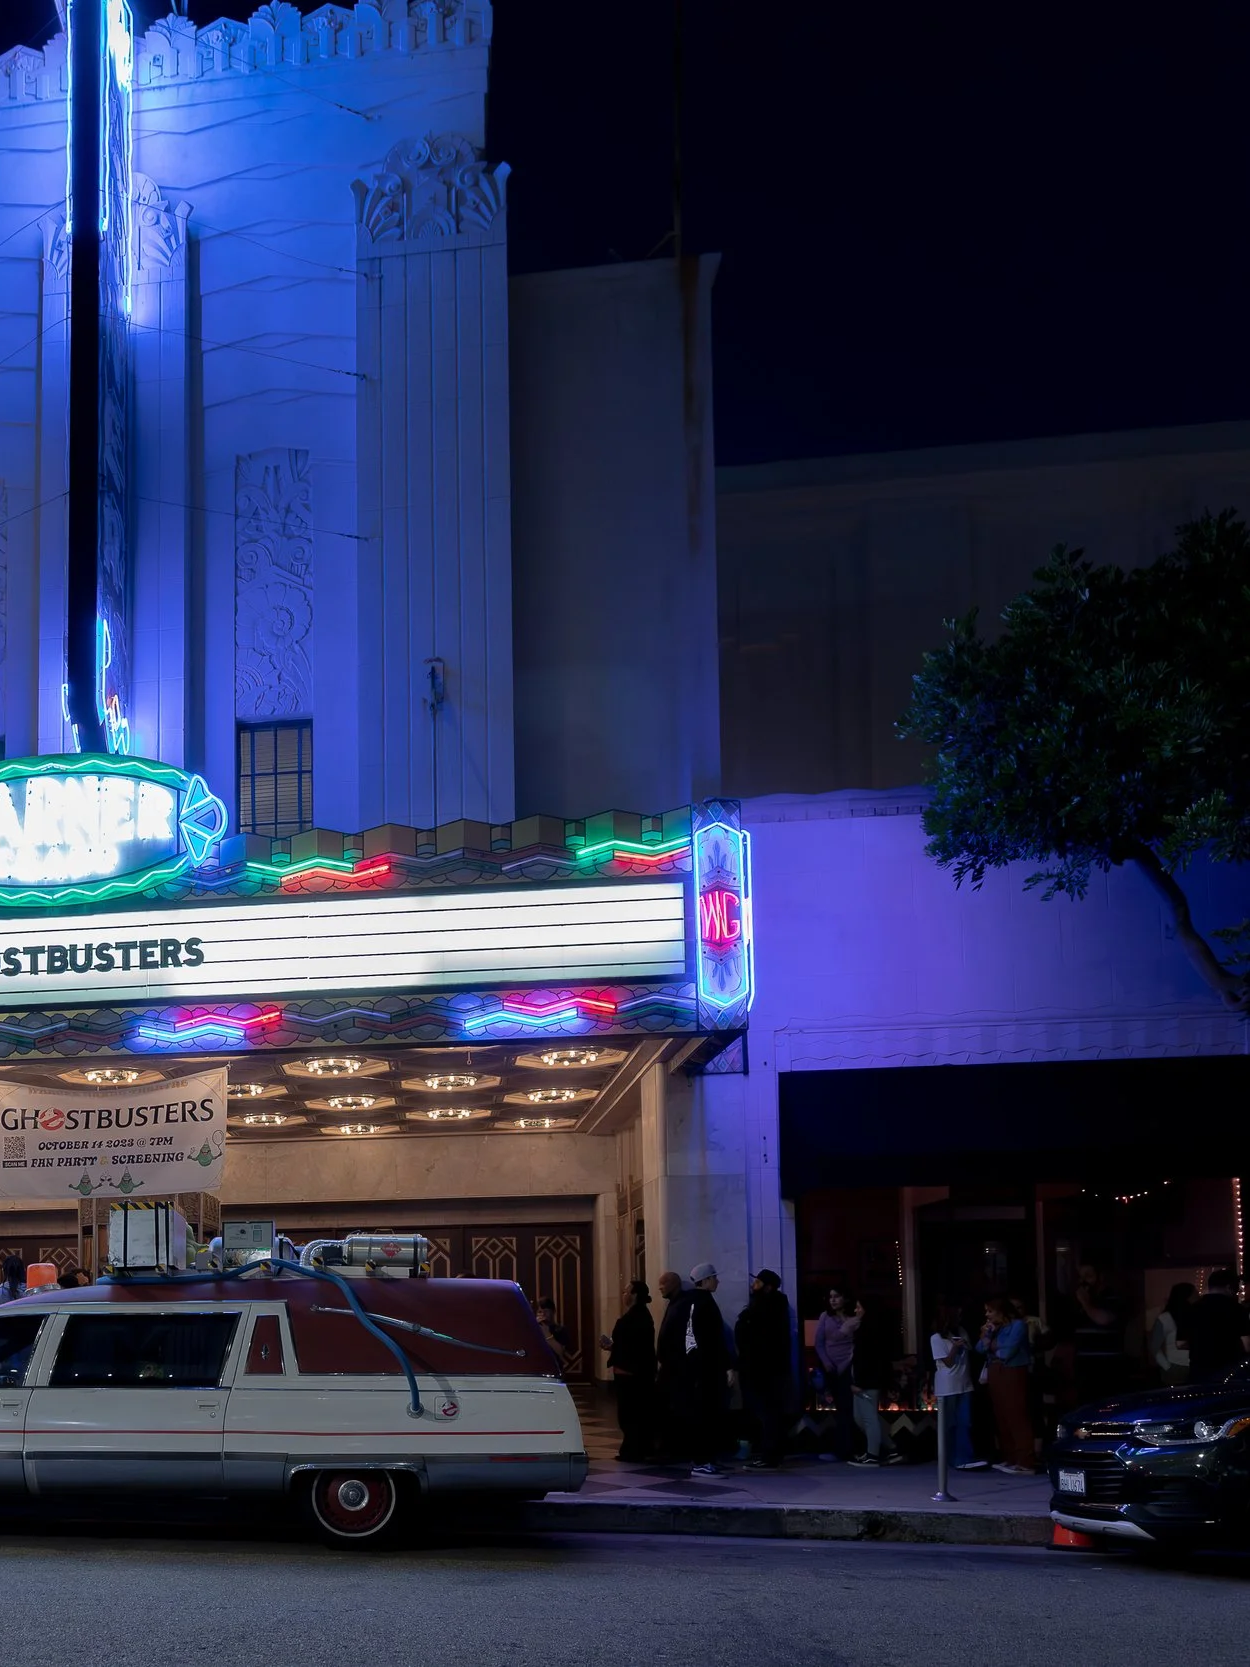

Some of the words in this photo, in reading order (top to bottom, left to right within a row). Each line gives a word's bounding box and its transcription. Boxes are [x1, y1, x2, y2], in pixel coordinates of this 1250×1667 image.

[38, 1139, 91, 1151] OCTOBER
[92, 1139, 104, 1150] 14
[105, 1138, 134, 1150] 2023
[136, 1138, 147, 1148] @
[149, 1136, 174, 1146] 7PM
[30, 1157, 54, 1168] FAN
[57, 1156, 98, 1168] PARTY
[111, 1151, 185, 1165] SCREENING
